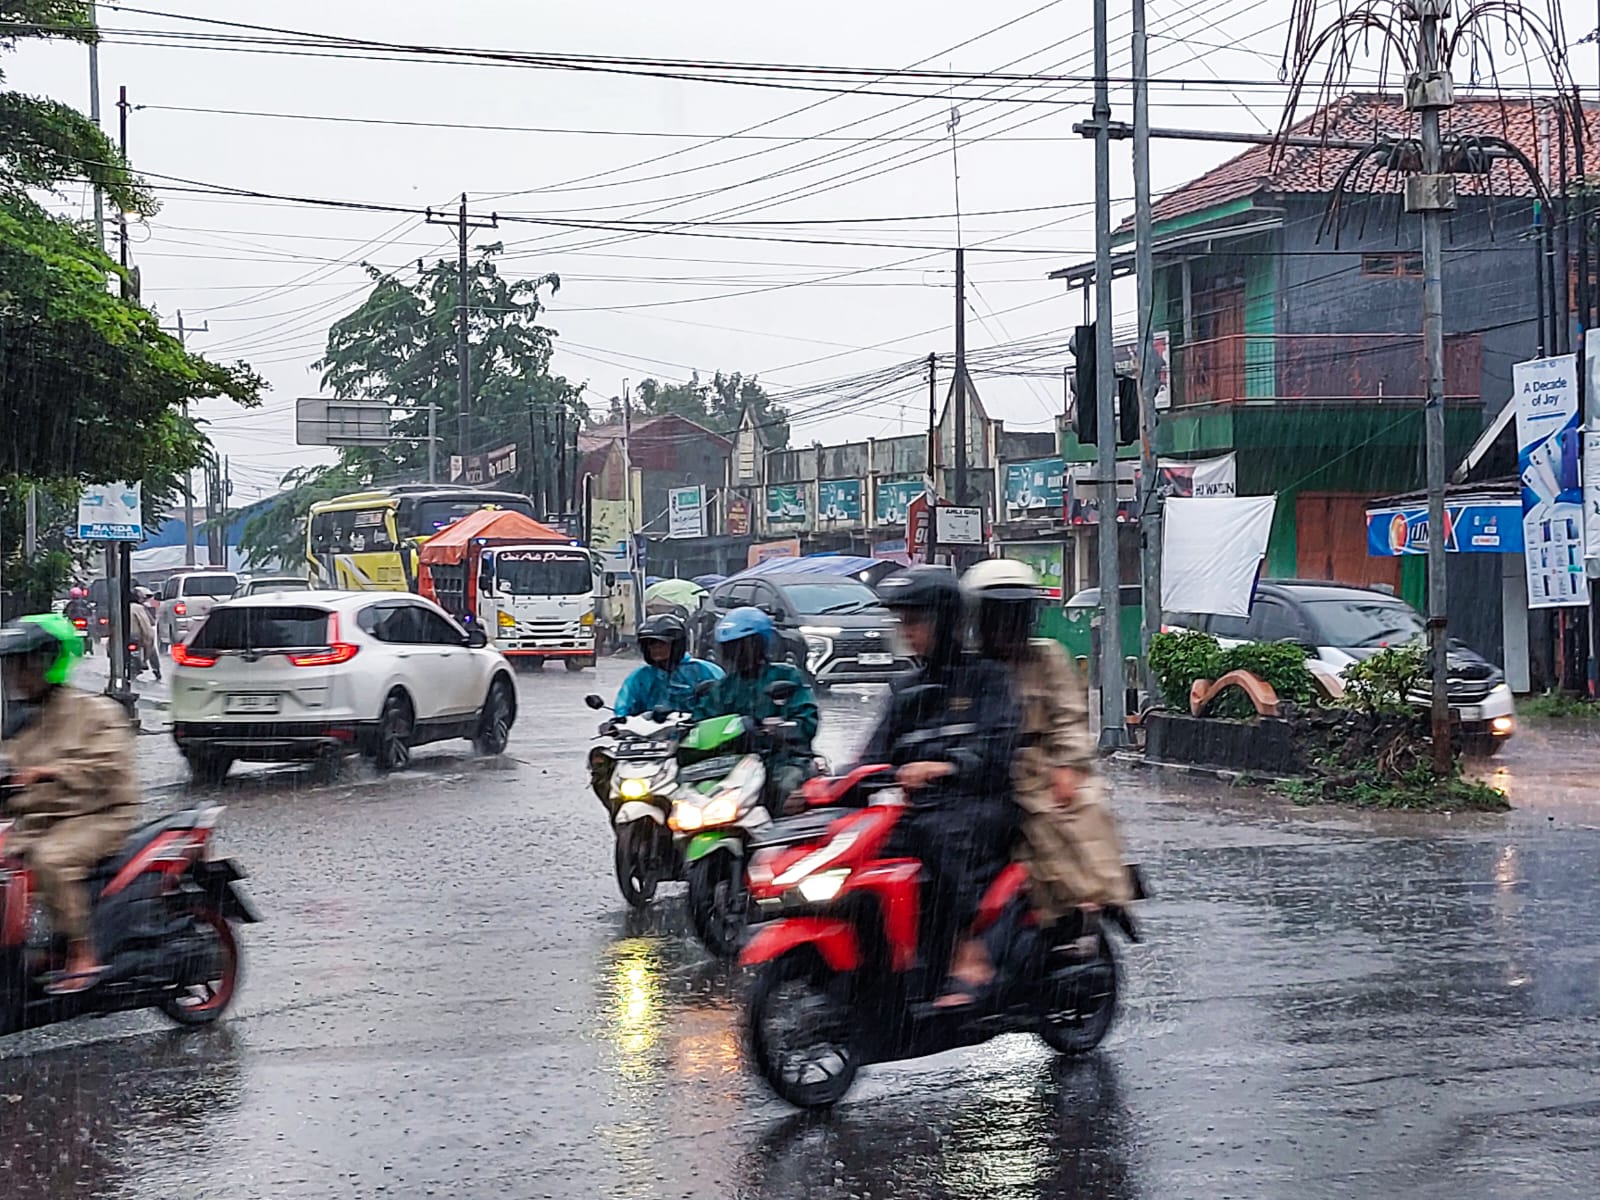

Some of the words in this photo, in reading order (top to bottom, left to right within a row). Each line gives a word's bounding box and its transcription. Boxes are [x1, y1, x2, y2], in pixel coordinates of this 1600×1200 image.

[1523, 382, 1531, 394] A
[1533, 377, 1568, 392] Decade
[1532, 393, 1542, 407] of
[1543, 393, 1560, 407] Joy
